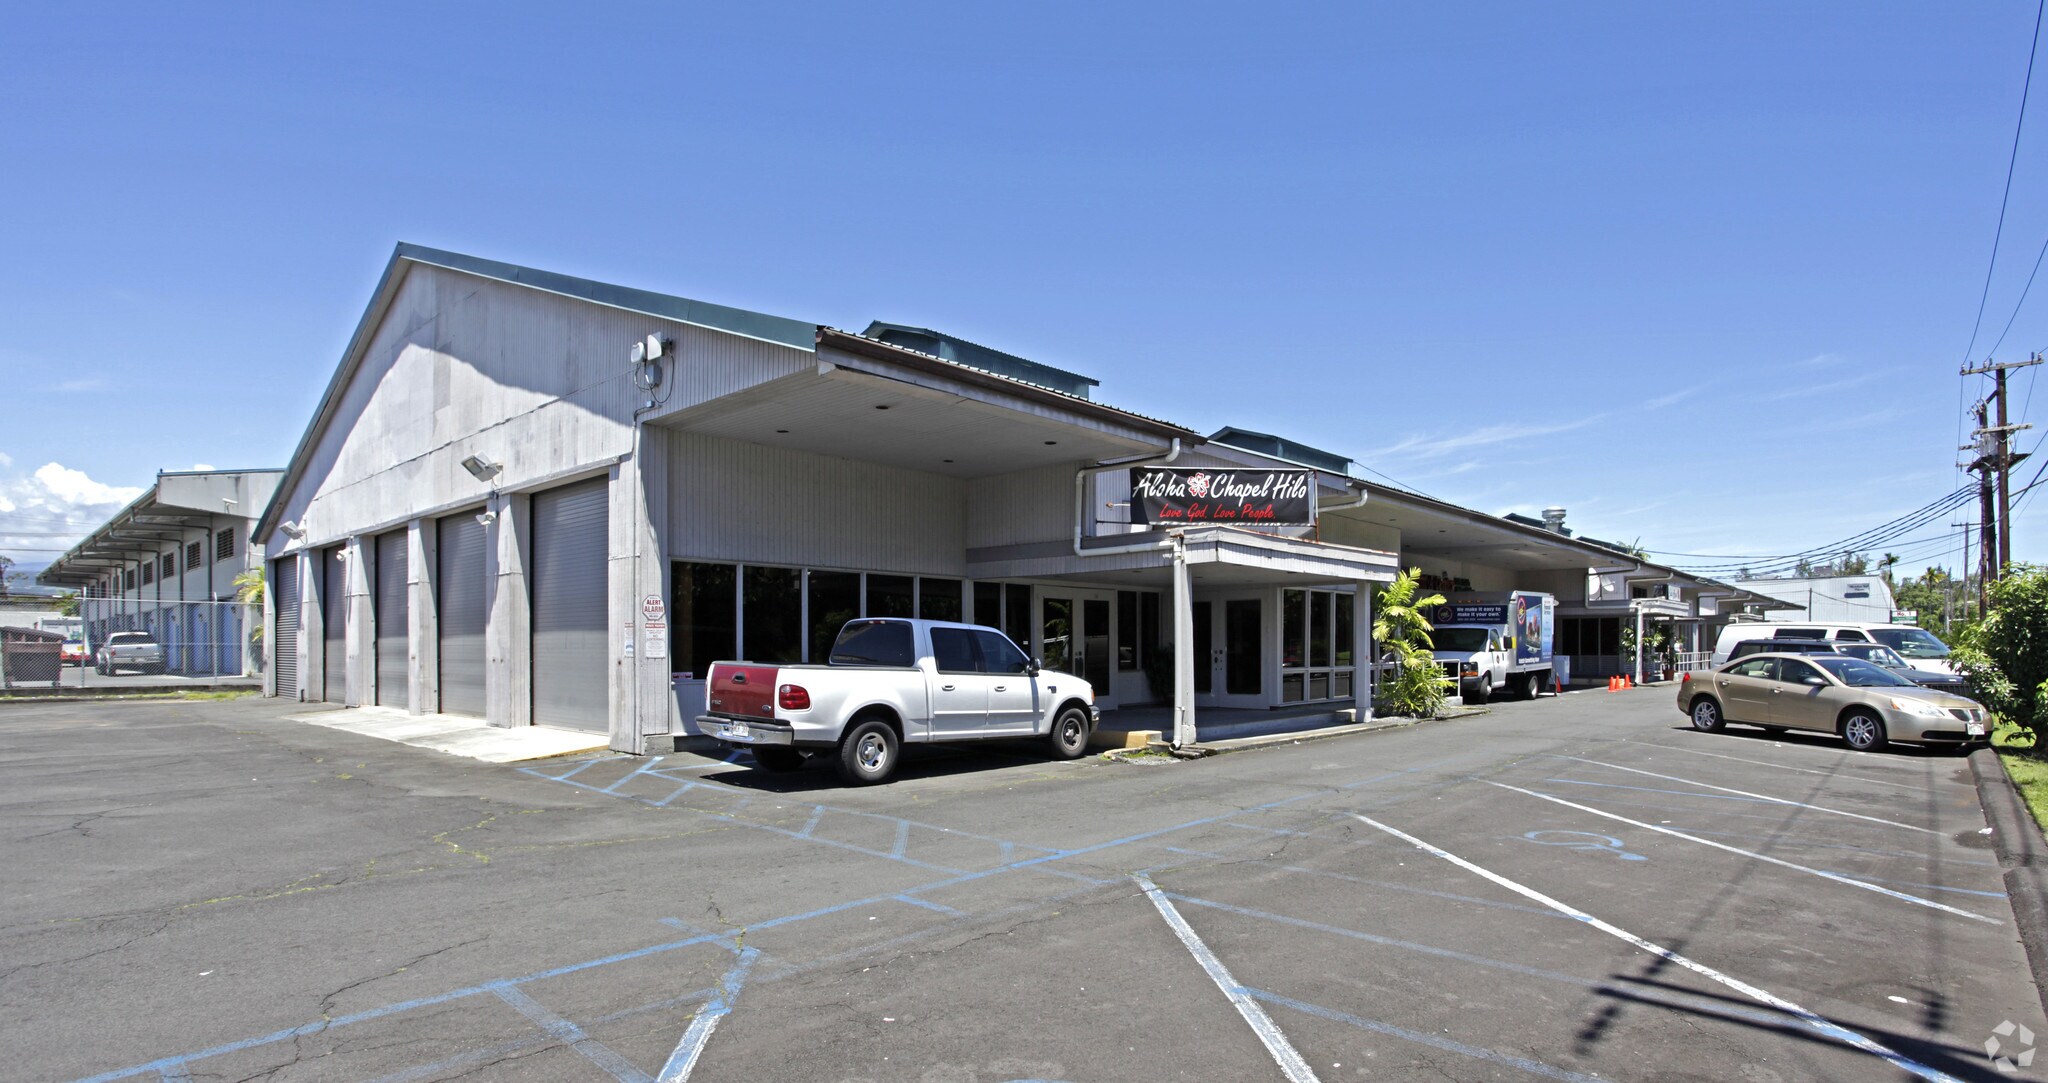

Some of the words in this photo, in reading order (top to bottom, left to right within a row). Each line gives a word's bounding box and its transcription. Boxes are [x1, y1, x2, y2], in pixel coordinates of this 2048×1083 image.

[1132, 472, 1184, 498] Aloha
[1210, 473, 1272, 507] Chapel
[1272, 473, 1307, 500] Hilo
[1160, 503, 1182, 518] Love
[1213, 504, 1236, 519] Love
